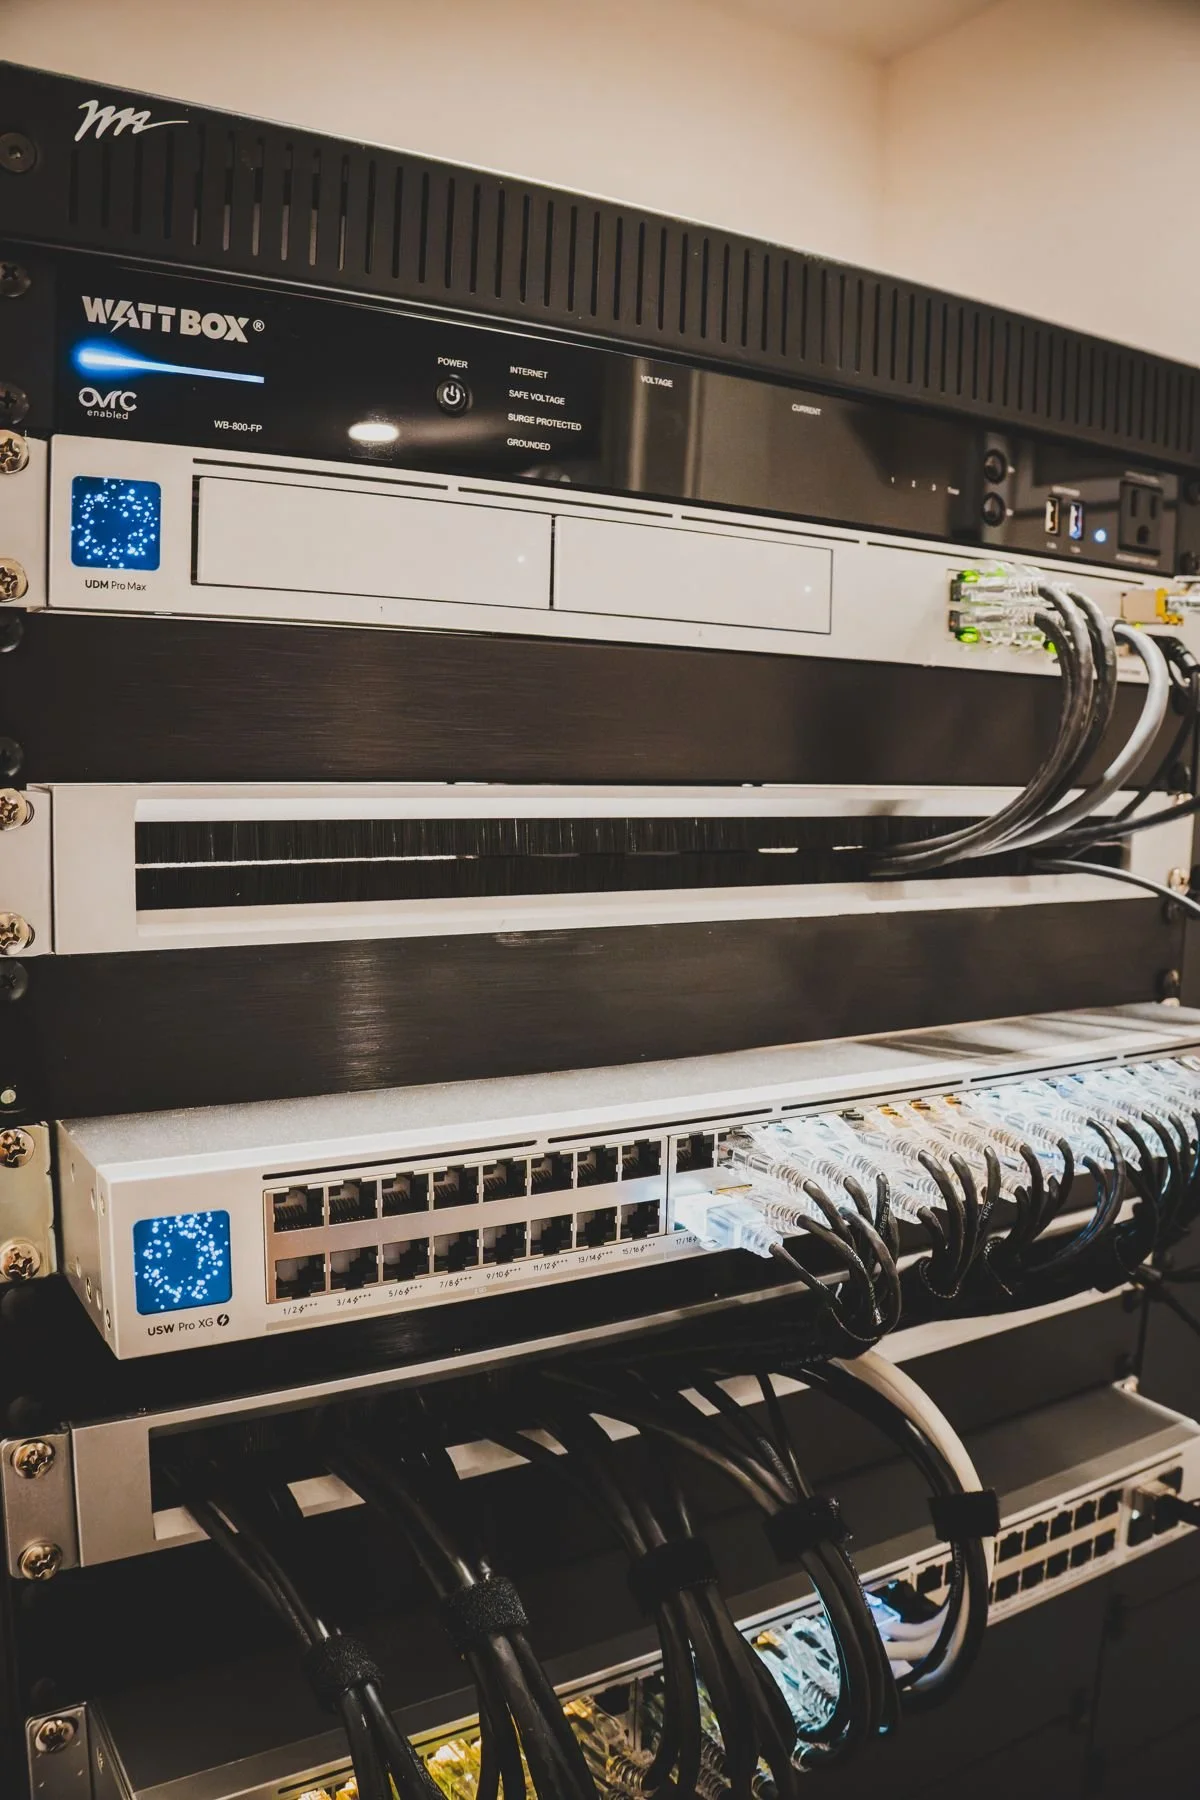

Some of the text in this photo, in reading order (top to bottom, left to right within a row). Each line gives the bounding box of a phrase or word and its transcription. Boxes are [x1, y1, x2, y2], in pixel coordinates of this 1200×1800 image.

[437, 356, 469, 369] POWER
[509, 365, 549, 379] INTERNET
[640, 375, 673, 388] VOLTAGE
[508, 389, 566, 406] SAFE VOLTAGE
[86, 409, 129, 420] enabled
[791, 403, 821, 416] CURRENT
[213, 419, 263, 432] WB-800-FP
[507, 412, 582, 431] SURGE PROTECTED
[506, 437, 551, 451] GROUNDED
[84, 579, 147, 591] UDM Pro Max
[147, 1317, 214, 1336] USW Pro XG
